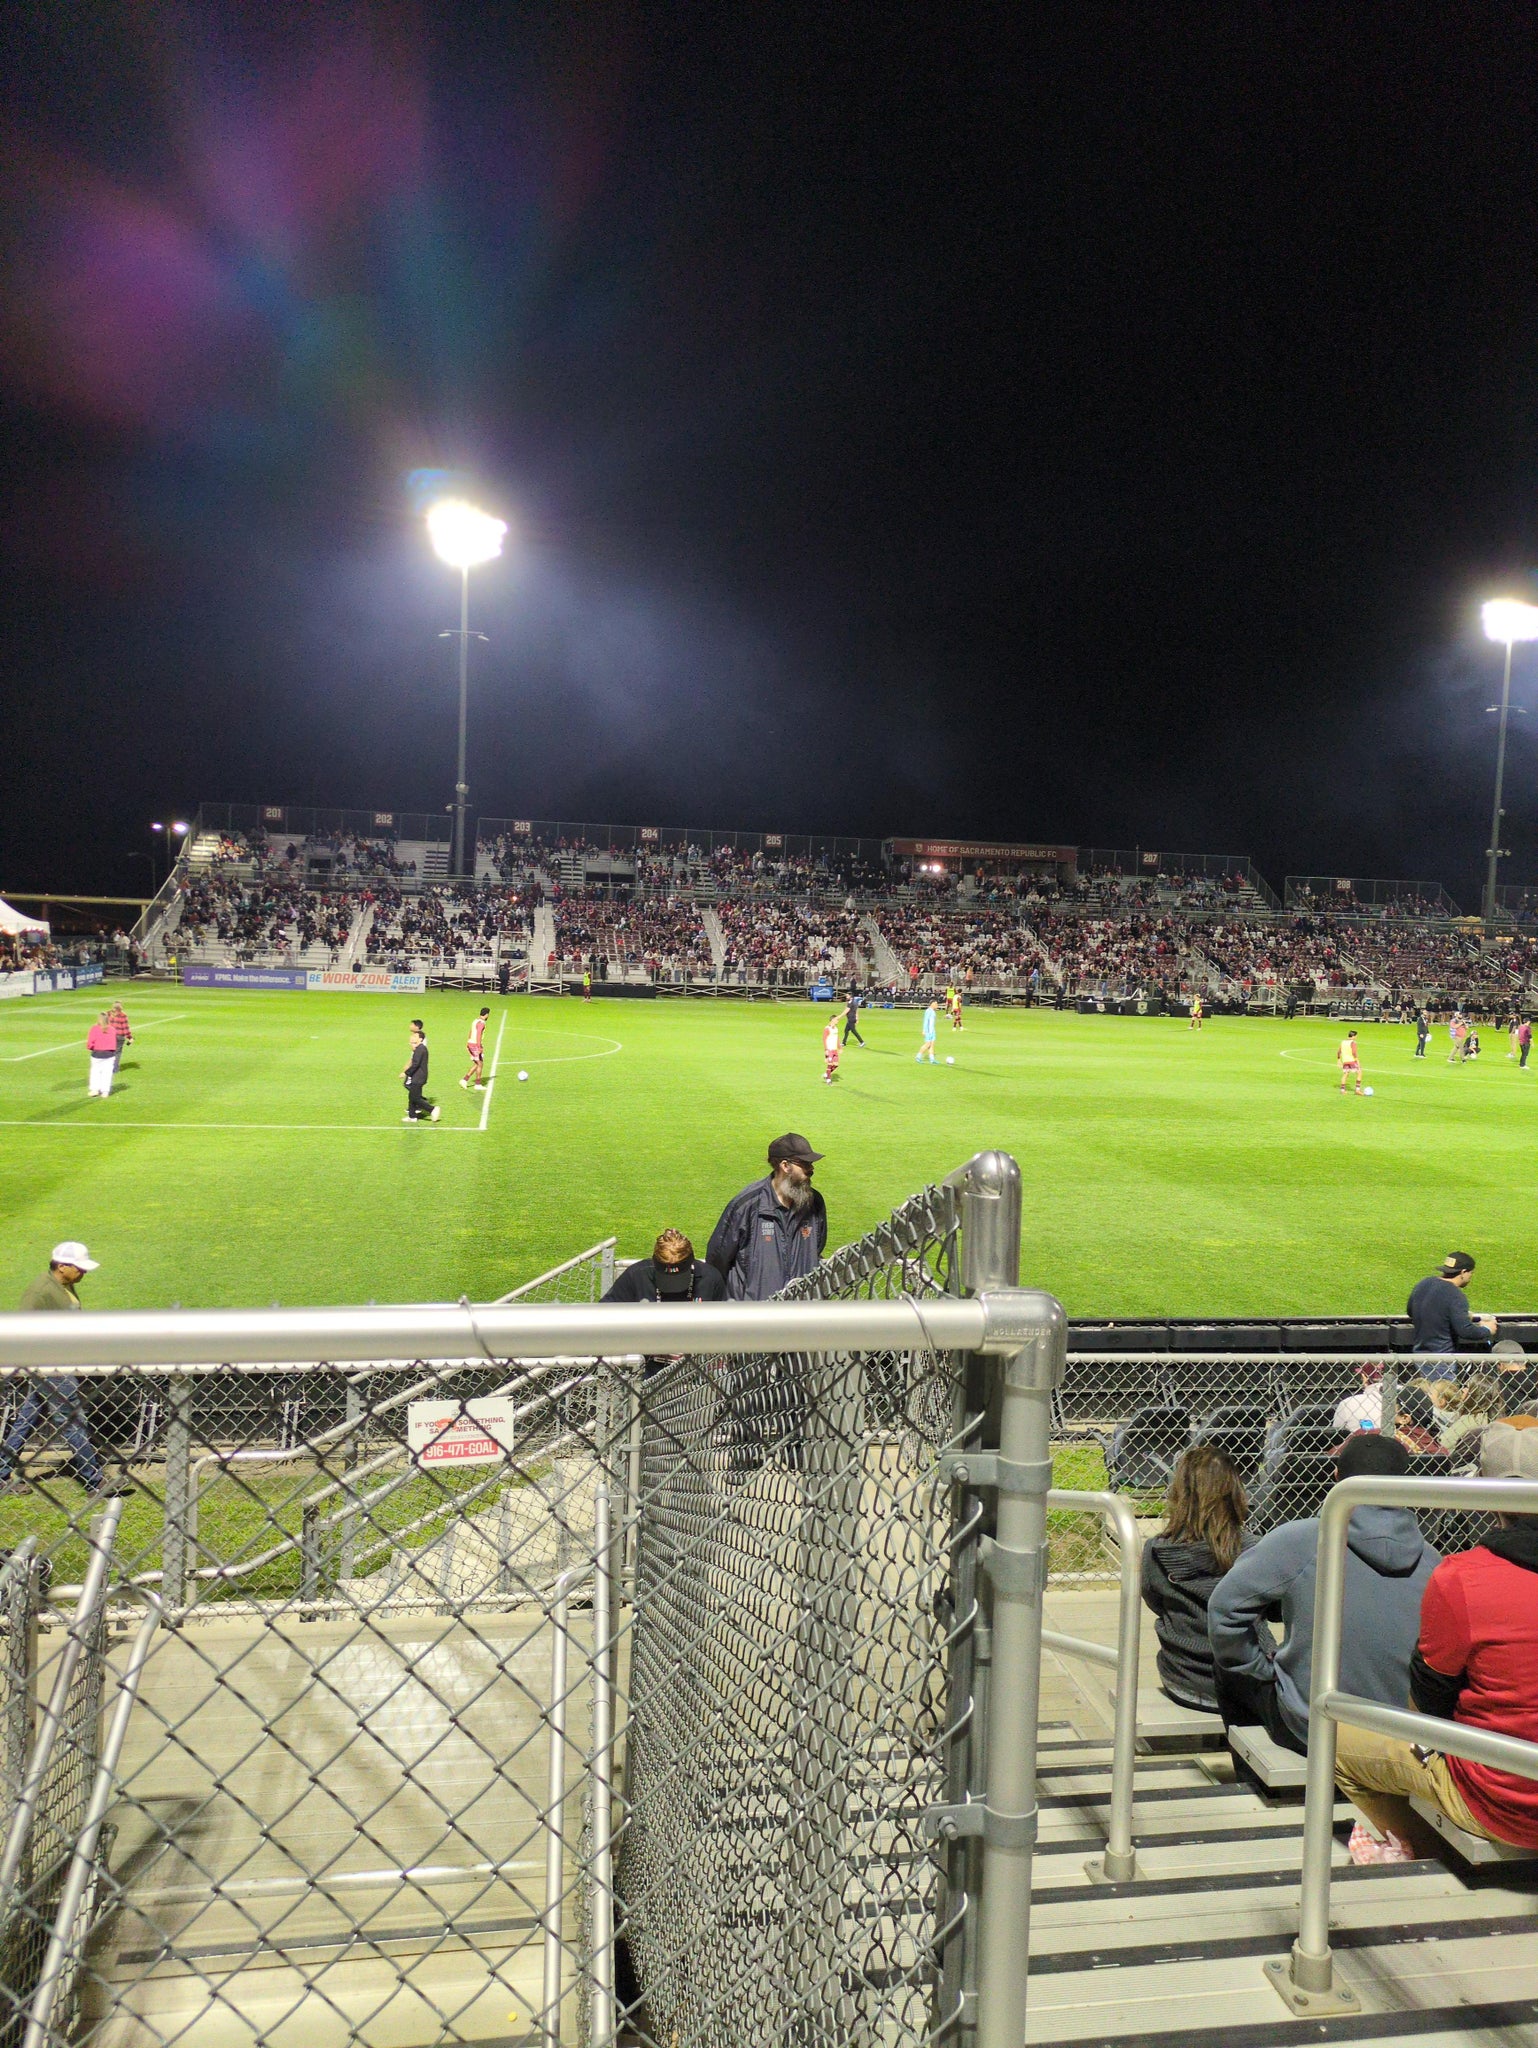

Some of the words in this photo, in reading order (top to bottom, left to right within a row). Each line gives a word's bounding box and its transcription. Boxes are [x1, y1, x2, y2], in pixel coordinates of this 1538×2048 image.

[265, 808, 281, 818] 201
[375, 814, 392, 824] 202
[514, 821, 531, 832] 203
[641, 828, 658, 838] 204
[766, 835, 782, 845] 205
[927, 845, 948, 853] HOME
[960, 847, 1010, 855] SACRAMENTO
[1011, 849, 1046, 857] REPUBLIC
[1047, 850, 1057, 858] FC
[1143, 853, 1158, 863] 207
[1336, 880, 1351, 889] 208
[308, 973, 321, 982] BE
[322, 973, 359, 984] WORK
[360, 974, 391, 985] ZONE
[392, 975, 422, 984] ALERT
[426, 1441, 494, 1458] 916-471-GOAL
[1435, 1813, 1442, 1828] 3
